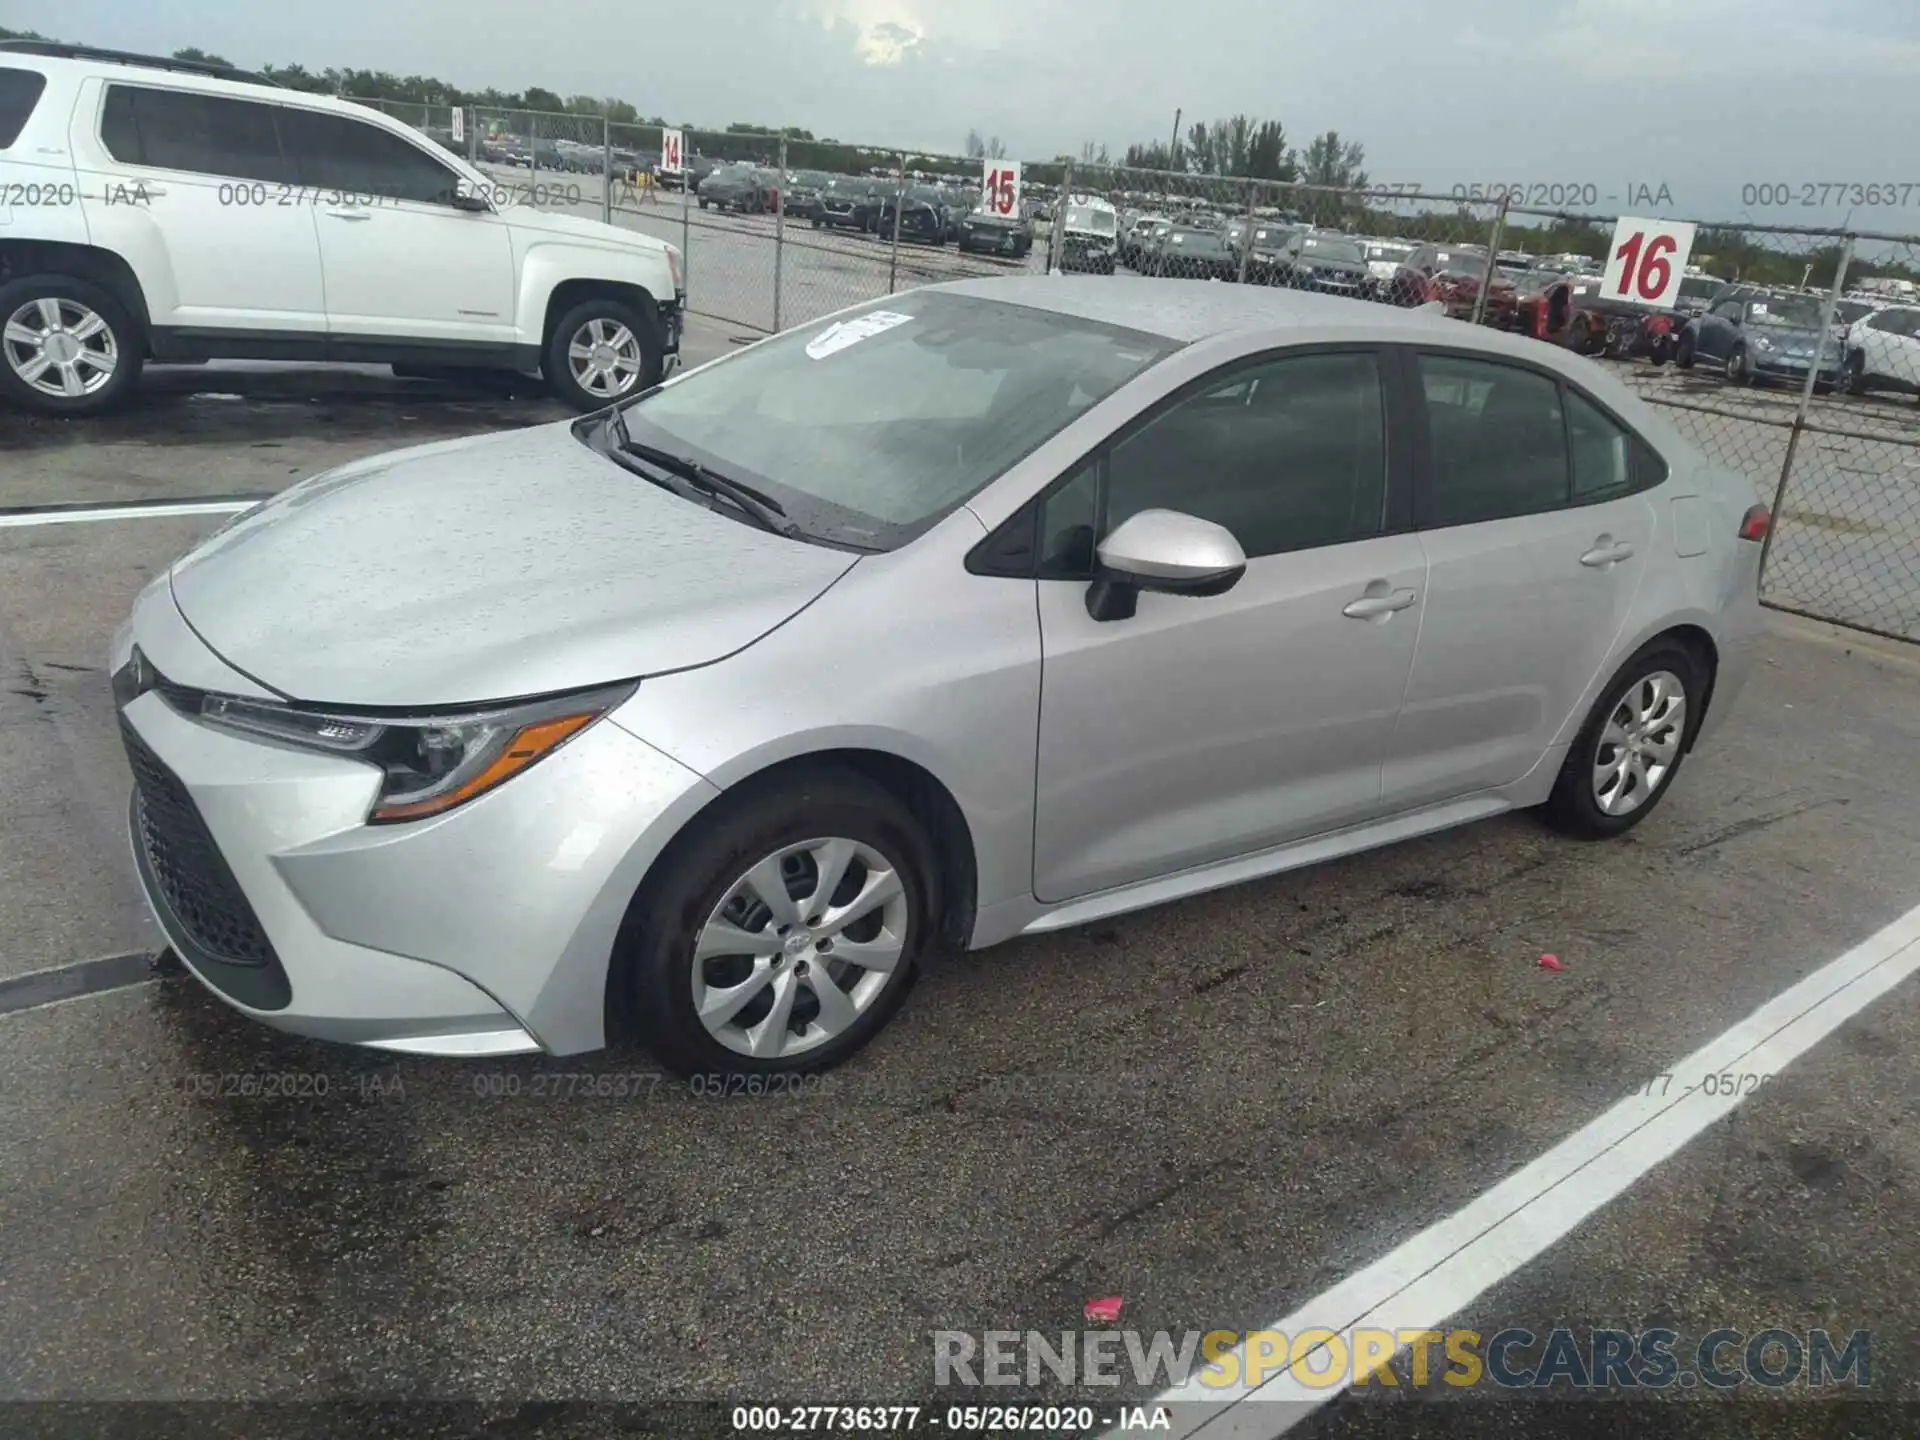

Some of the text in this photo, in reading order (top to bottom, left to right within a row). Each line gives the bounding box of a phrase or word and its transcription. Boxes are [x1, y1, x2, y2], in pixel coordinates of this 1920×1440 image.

[664, 136, 679, 168] 14
[986, 168, 1015, 215] 15
[1616, 231, 1678, 300] 16
